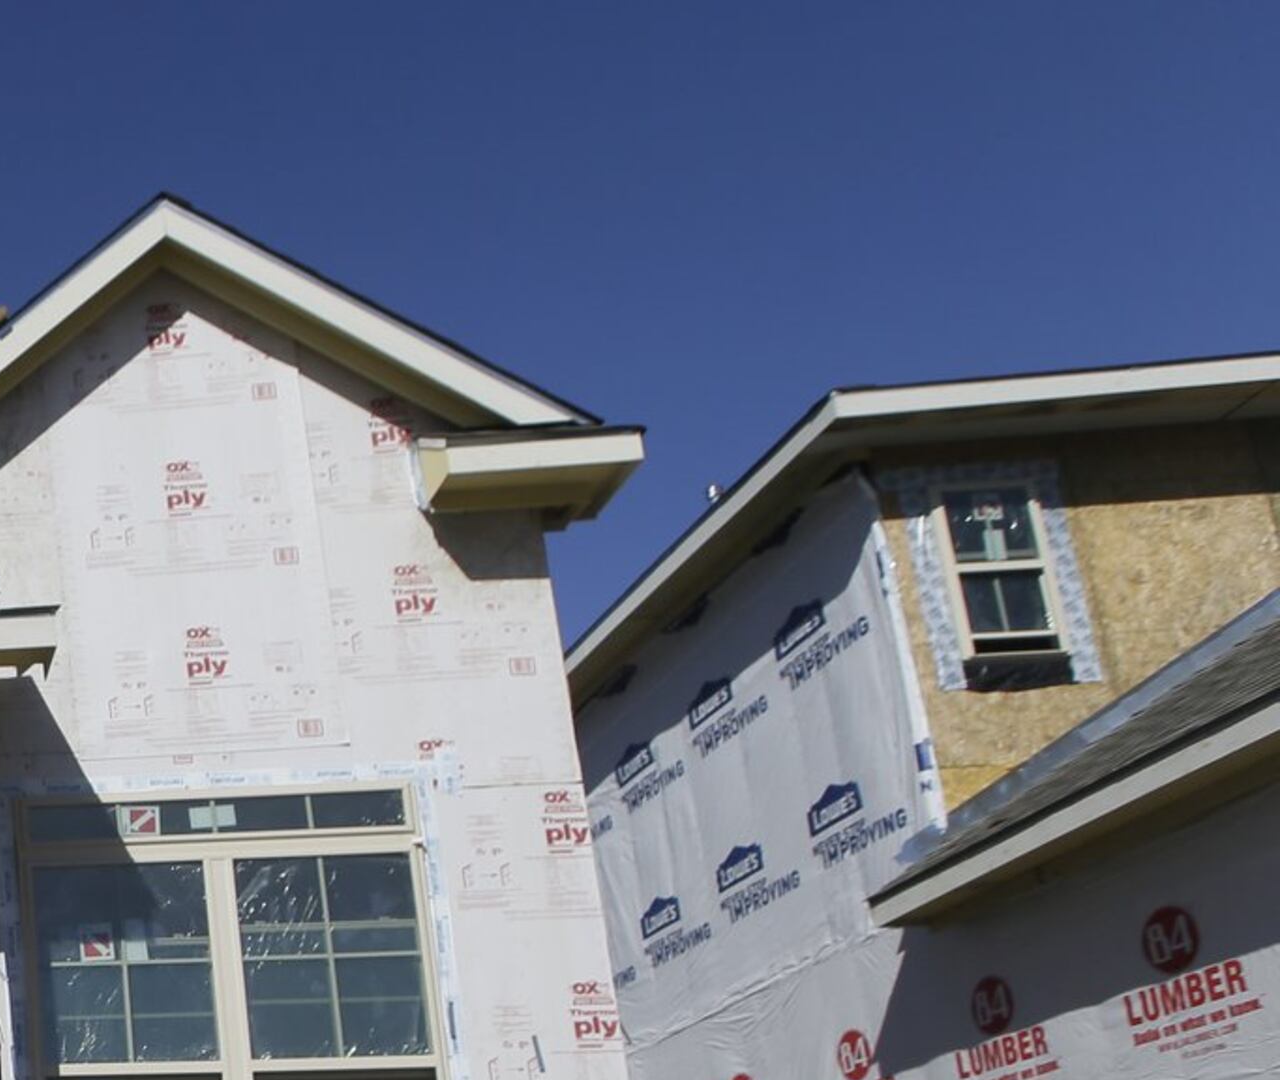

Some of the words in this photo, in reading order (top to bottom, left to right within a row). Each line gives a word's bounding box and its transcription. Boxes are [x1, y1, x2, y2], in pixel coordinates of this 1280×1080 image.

[148, 329, 187, 351] ply
[371, 425, 412, 447] ply
[167, 490, 208, 509] ply
[395, 595, 437, 615] ply
[186, 657, 228, 678] ply
[545, 823, 590, 848] ply
[821, 807, 907, 869] IMPROVING
[726, 869, 801, 925] IMPROVING
[1147, 914, 1192, 964] 84
[1123, 959, 1248, 1027] LUMBER
[573, 1016, 621, 1040] ply
[840, 1036, 868, 1073] 84
[956, 1025, 1049, 1080] LUMBER
